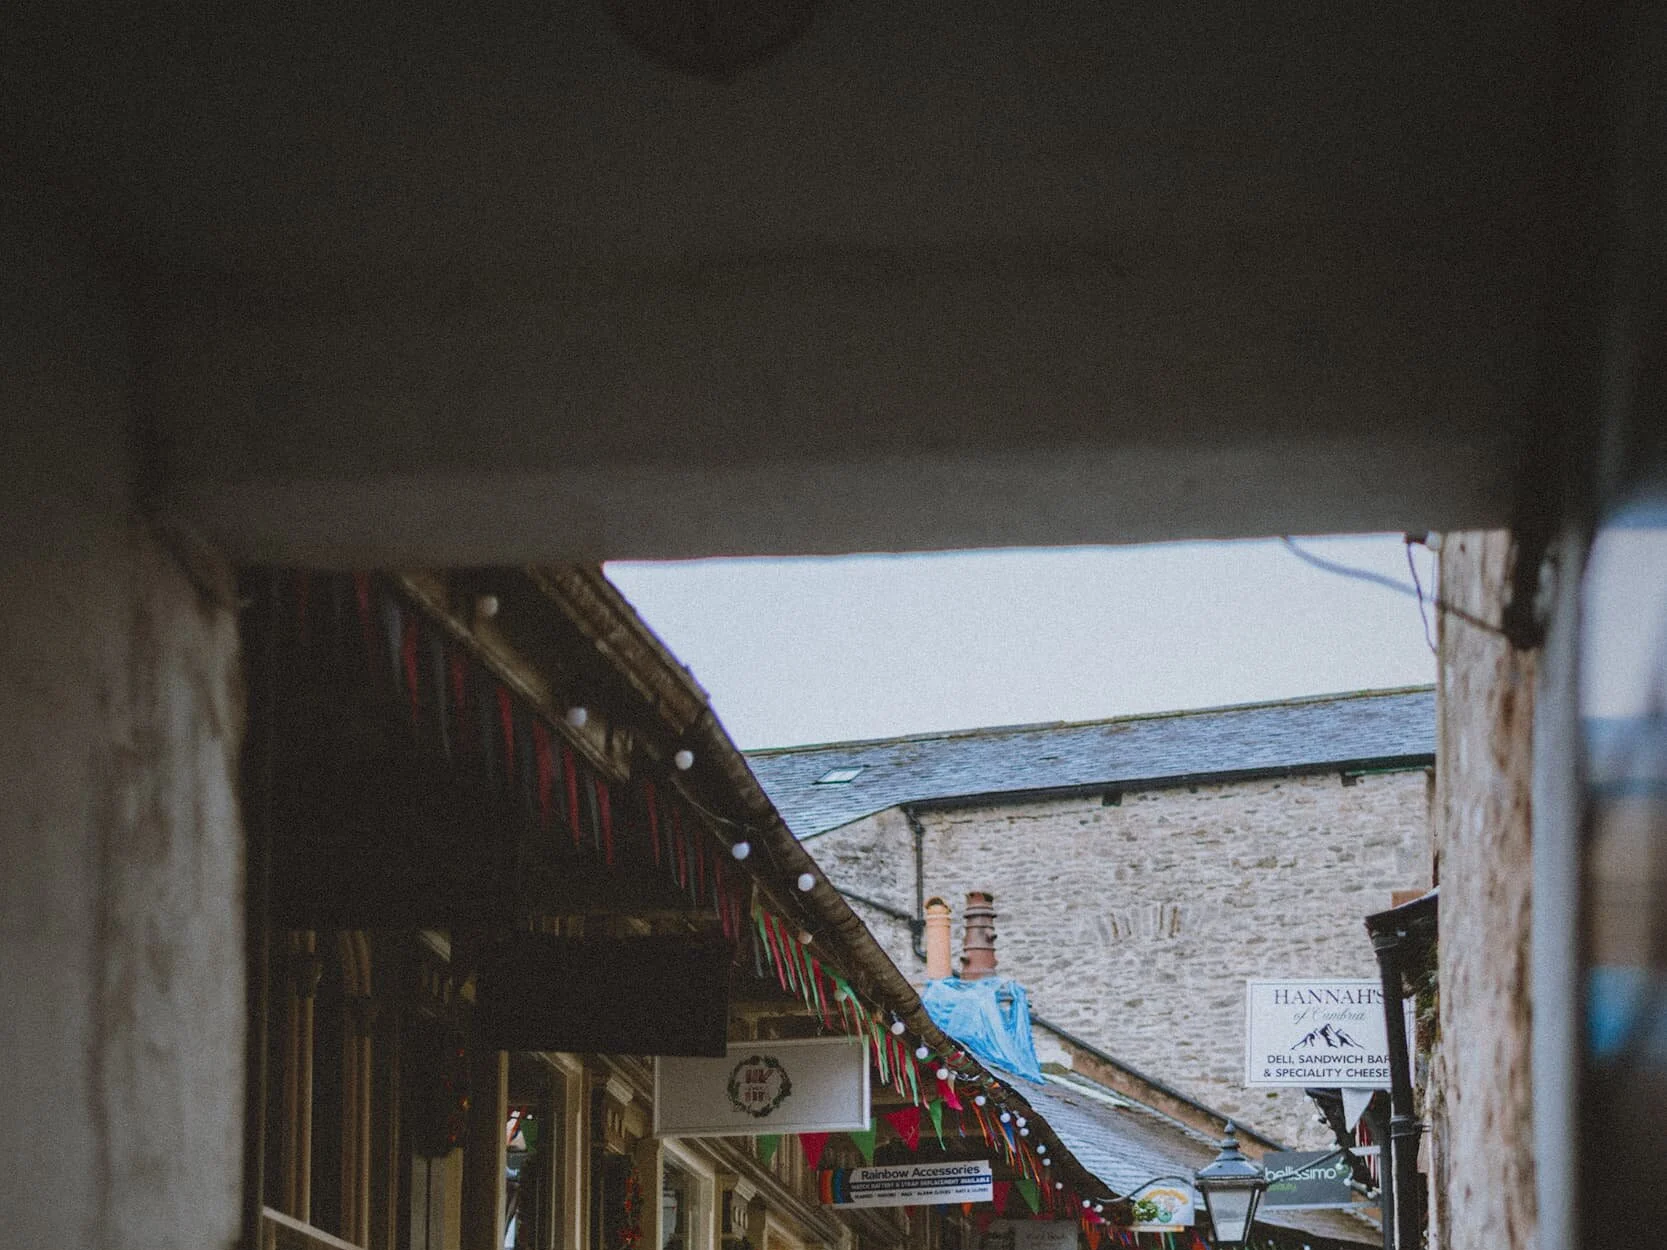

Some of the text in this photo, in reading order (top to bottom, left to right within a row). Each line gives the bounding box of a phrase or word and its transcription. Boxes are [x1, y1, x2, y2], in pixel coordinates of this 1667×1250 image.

[1274, 988, 1384, 1004] HANNAH'S
[1294, 1006, 1366, 1024] of Cumbria
[1267, 1055, 1295, 1065] DELI,
[1298, 1054, 1363, 1065] SANDWICH
[1263, 1068, 1272, 1078] &
[1275, 1068, 1341, 1078] SPECIALITY
[862, 1165, 981, 1180] Rainbow Accessories
[1264, 1166, 1336, 1181] bellissimo
